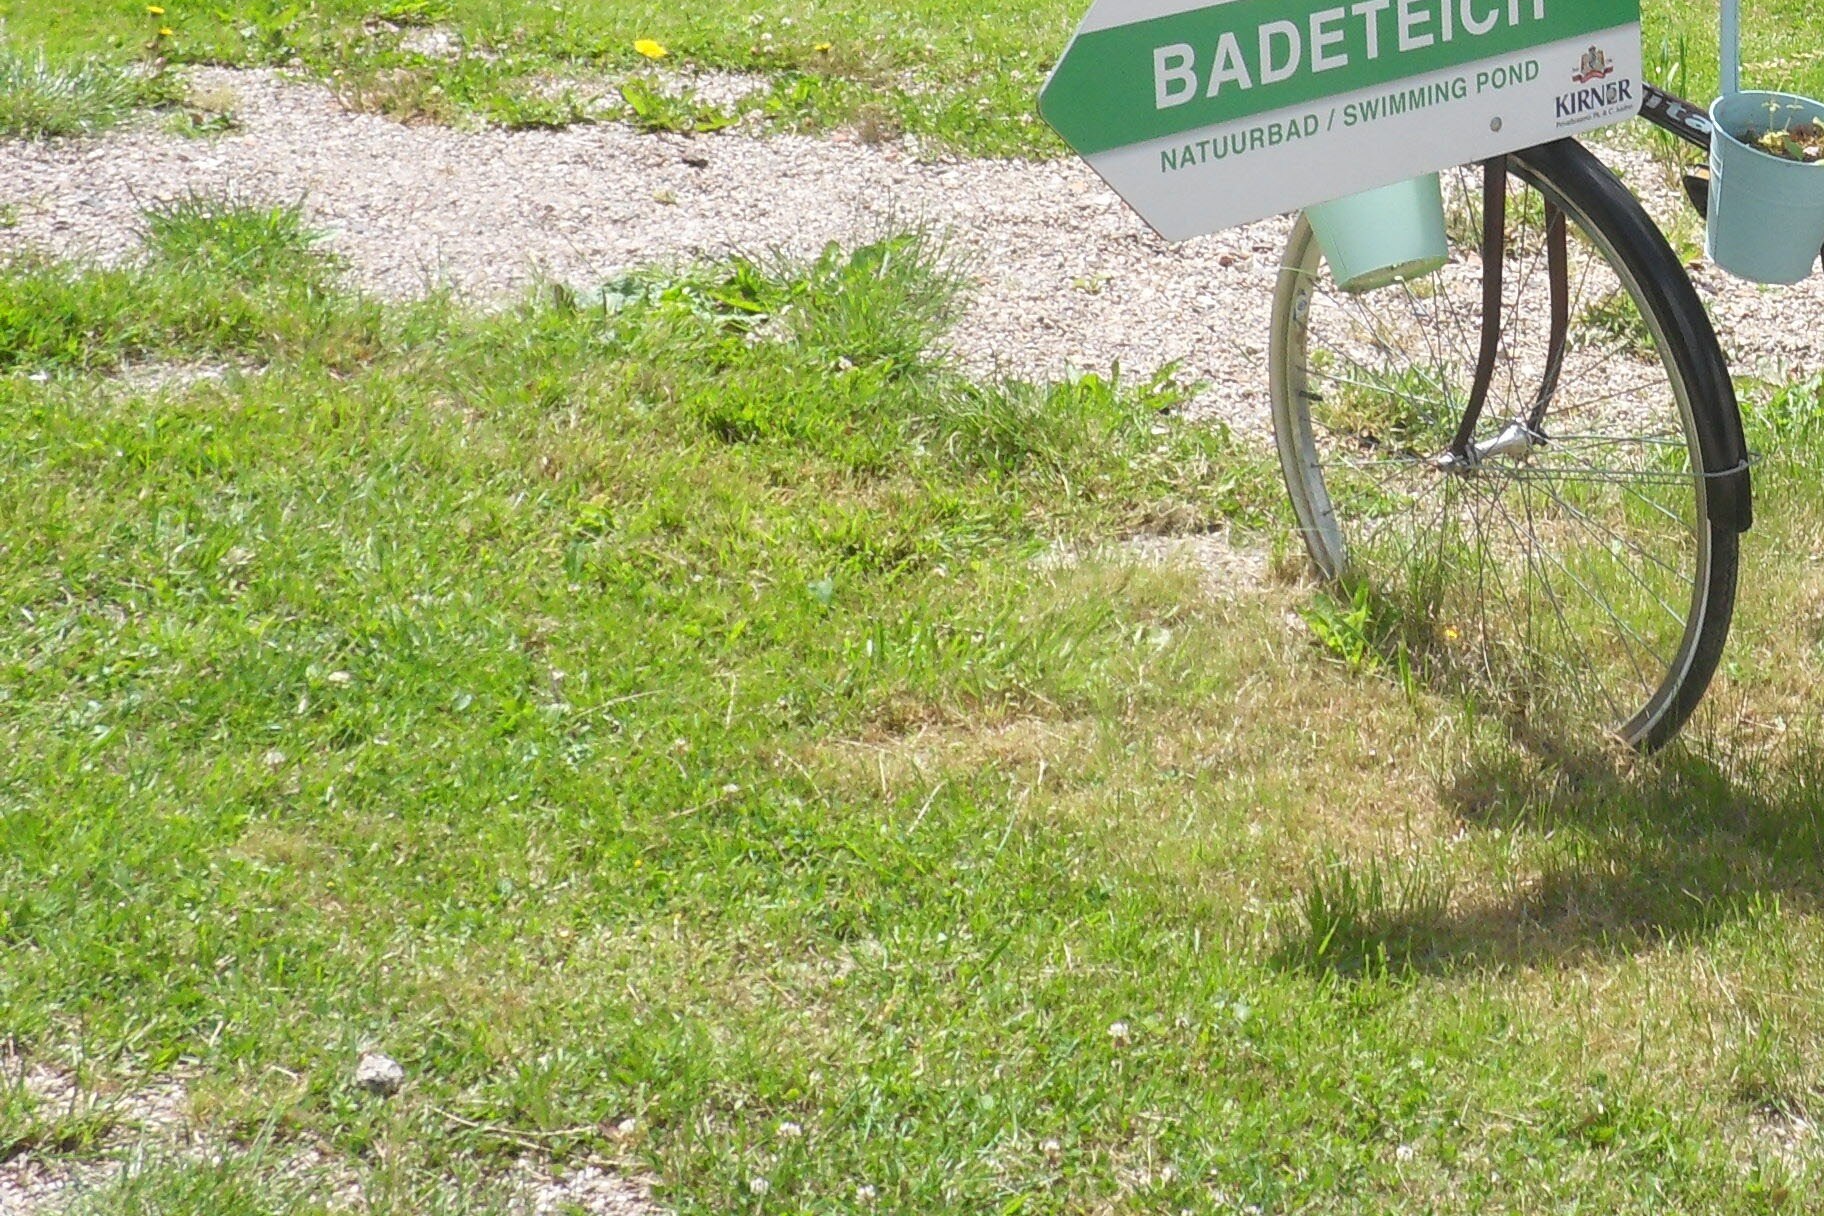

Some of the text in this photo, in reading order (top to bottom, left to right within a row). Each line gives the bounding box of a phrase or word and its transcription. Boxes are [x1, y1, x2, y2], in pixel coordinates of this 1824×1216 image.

[1160, 113, 1320, 173] NATUURBAD
[1343, 77, 1468, 127] SWIMMING
[1476, 59, 1540, 94] POND
[1556, 78, 1632, 118] KIRNER
